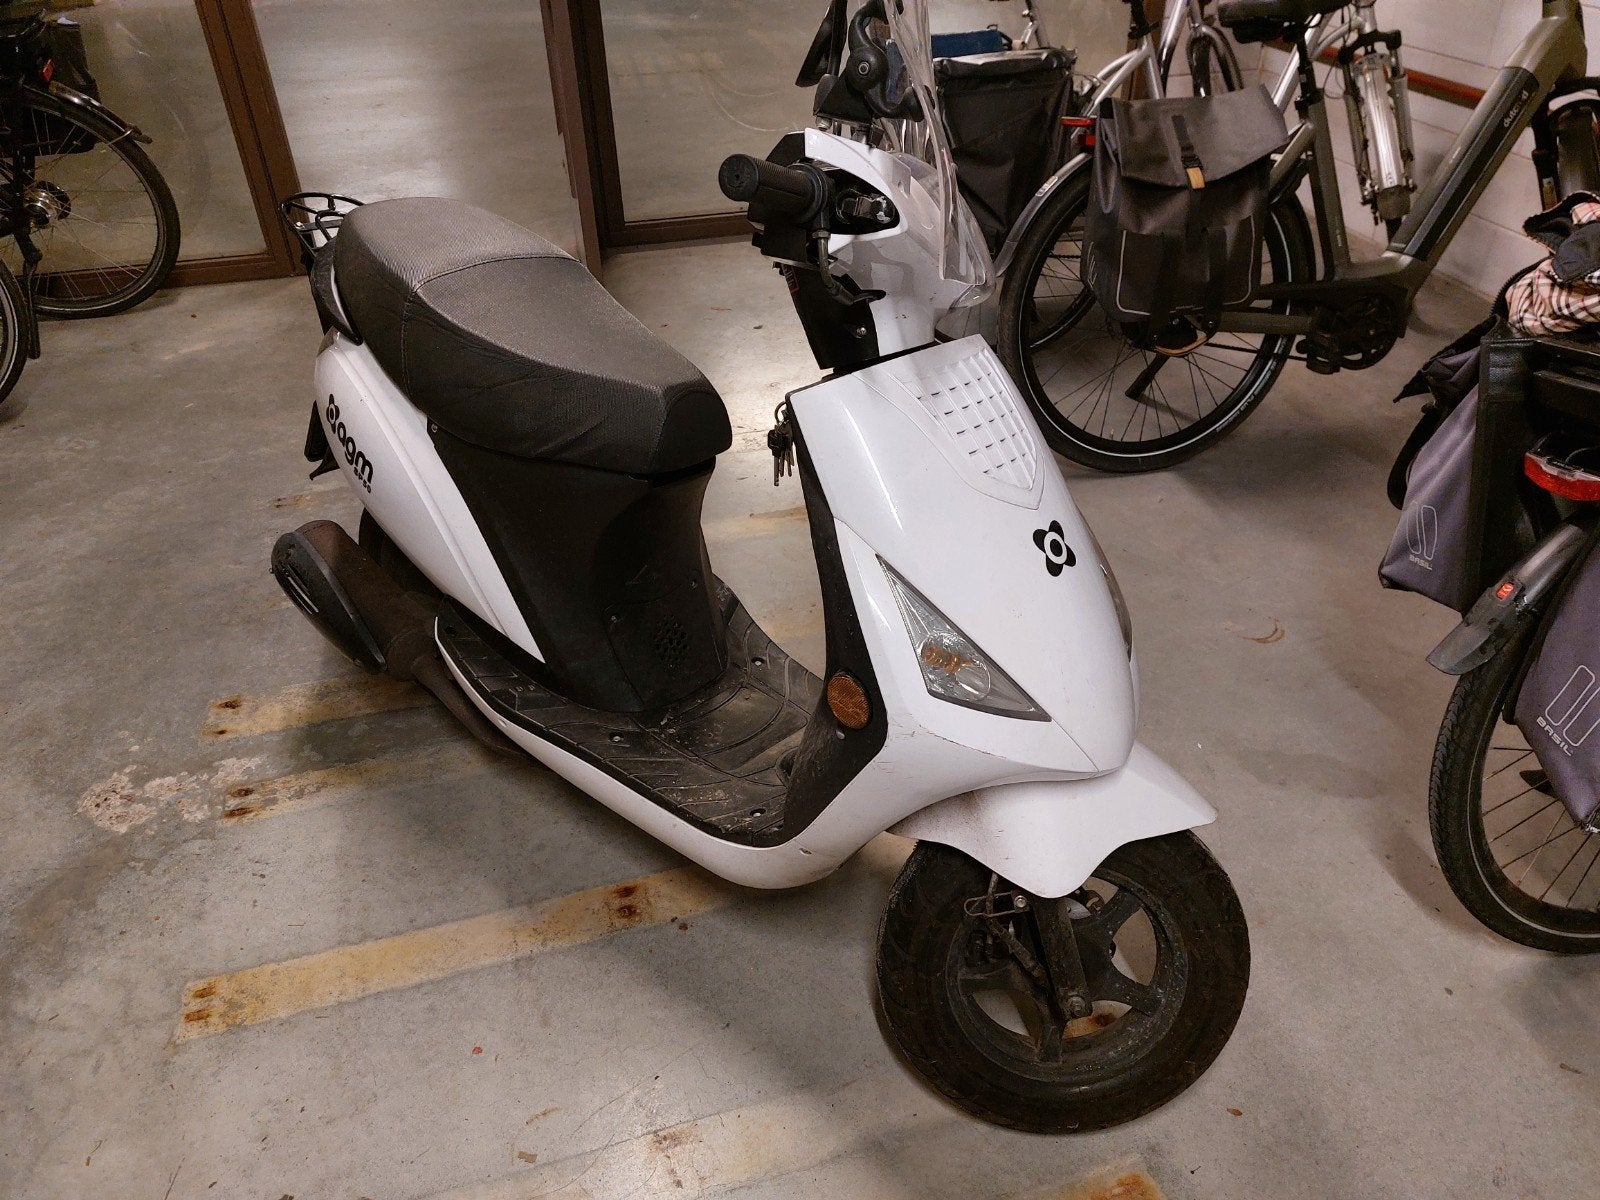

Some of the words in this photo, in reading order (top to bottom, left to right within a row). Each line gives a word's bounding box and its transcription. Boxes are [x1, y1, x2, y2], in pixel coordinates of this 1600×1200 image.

[337, 421, 374, 485] agm
[1409, 554, 1433, 571] BASIL
[1536, 716, 1572, 757] BASIL
